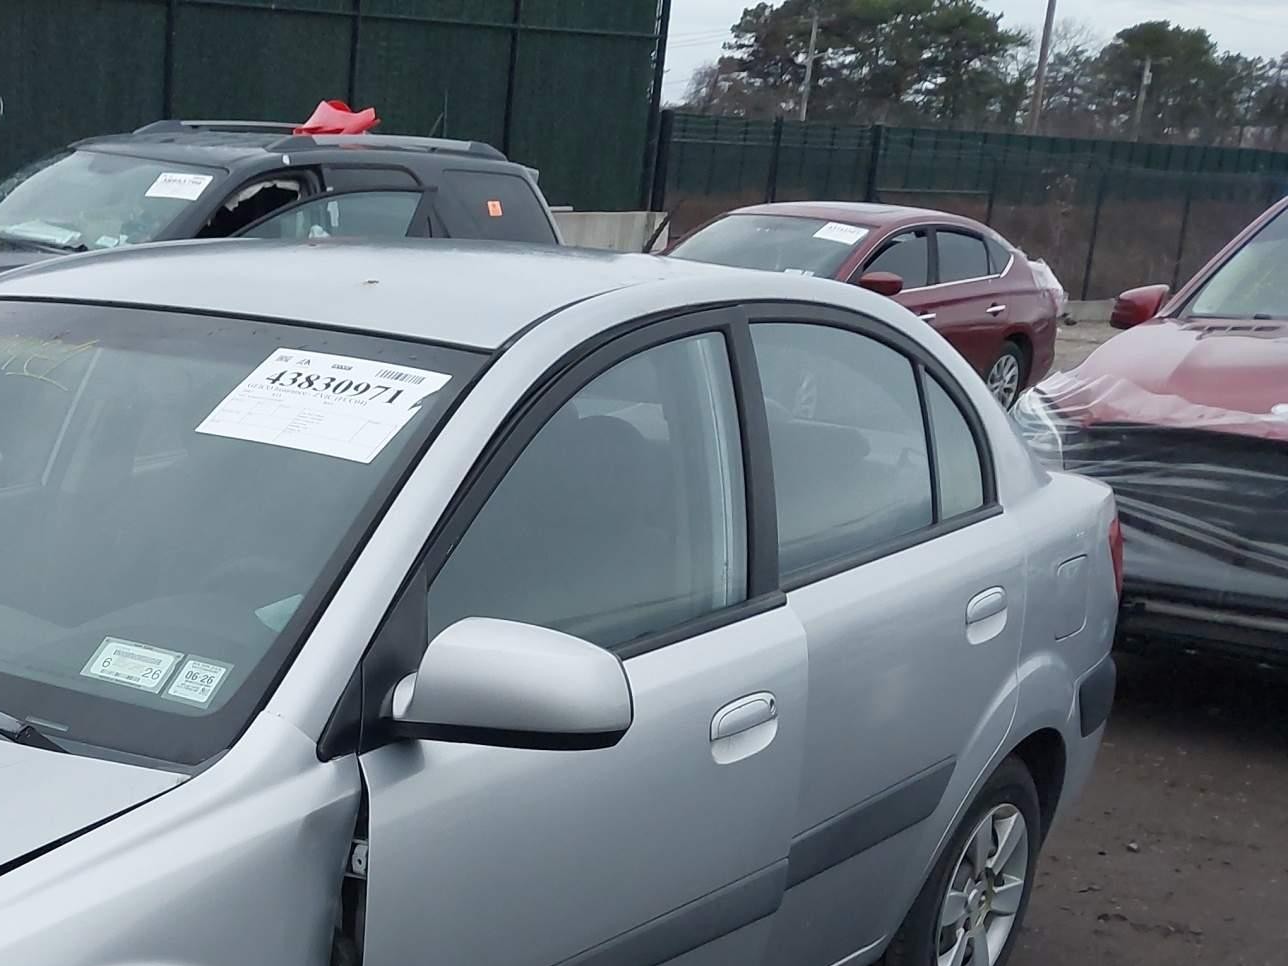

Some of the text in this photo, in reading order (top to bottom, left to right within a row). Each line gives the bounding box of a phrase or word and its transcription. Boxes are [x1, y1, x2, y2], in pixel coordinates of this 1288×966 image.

[266, 369, 404, 404] 43830971
[102, 657, 112, 668] 6
[141, 667, 162, 681] 26
